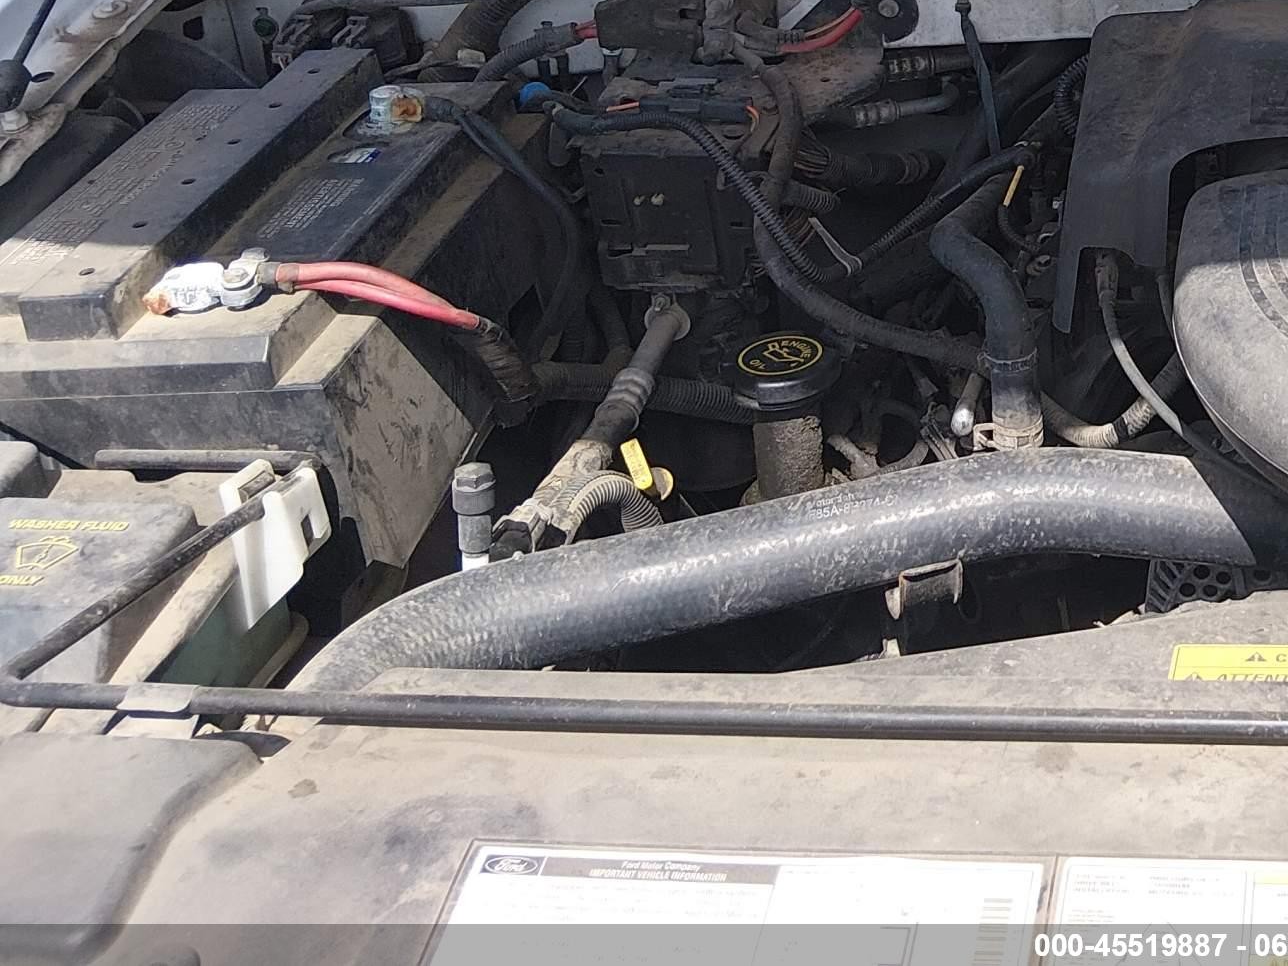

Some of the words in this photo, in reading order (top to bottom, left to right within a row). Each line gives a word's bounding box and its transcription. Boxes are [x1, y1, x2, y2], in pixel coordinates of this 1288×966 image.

[780, 340, 812, 359] ENGINE
[749, 359, 767, 370] OIL
[8, 519, 81, 531] WASHER
[81, 521, 130, 532] FLUID
[0, 575, 44, 586] ONLY
[494, 858, 528, 872] Ford
[620, 860, 641, 870] Ford
[663, 861, 701, 872] Company
[589, 868, 636, 879] IMPORTANT
[637, 869, 669, 880] VEHICLE
[670, 871, 727, 882] INFORMATION
